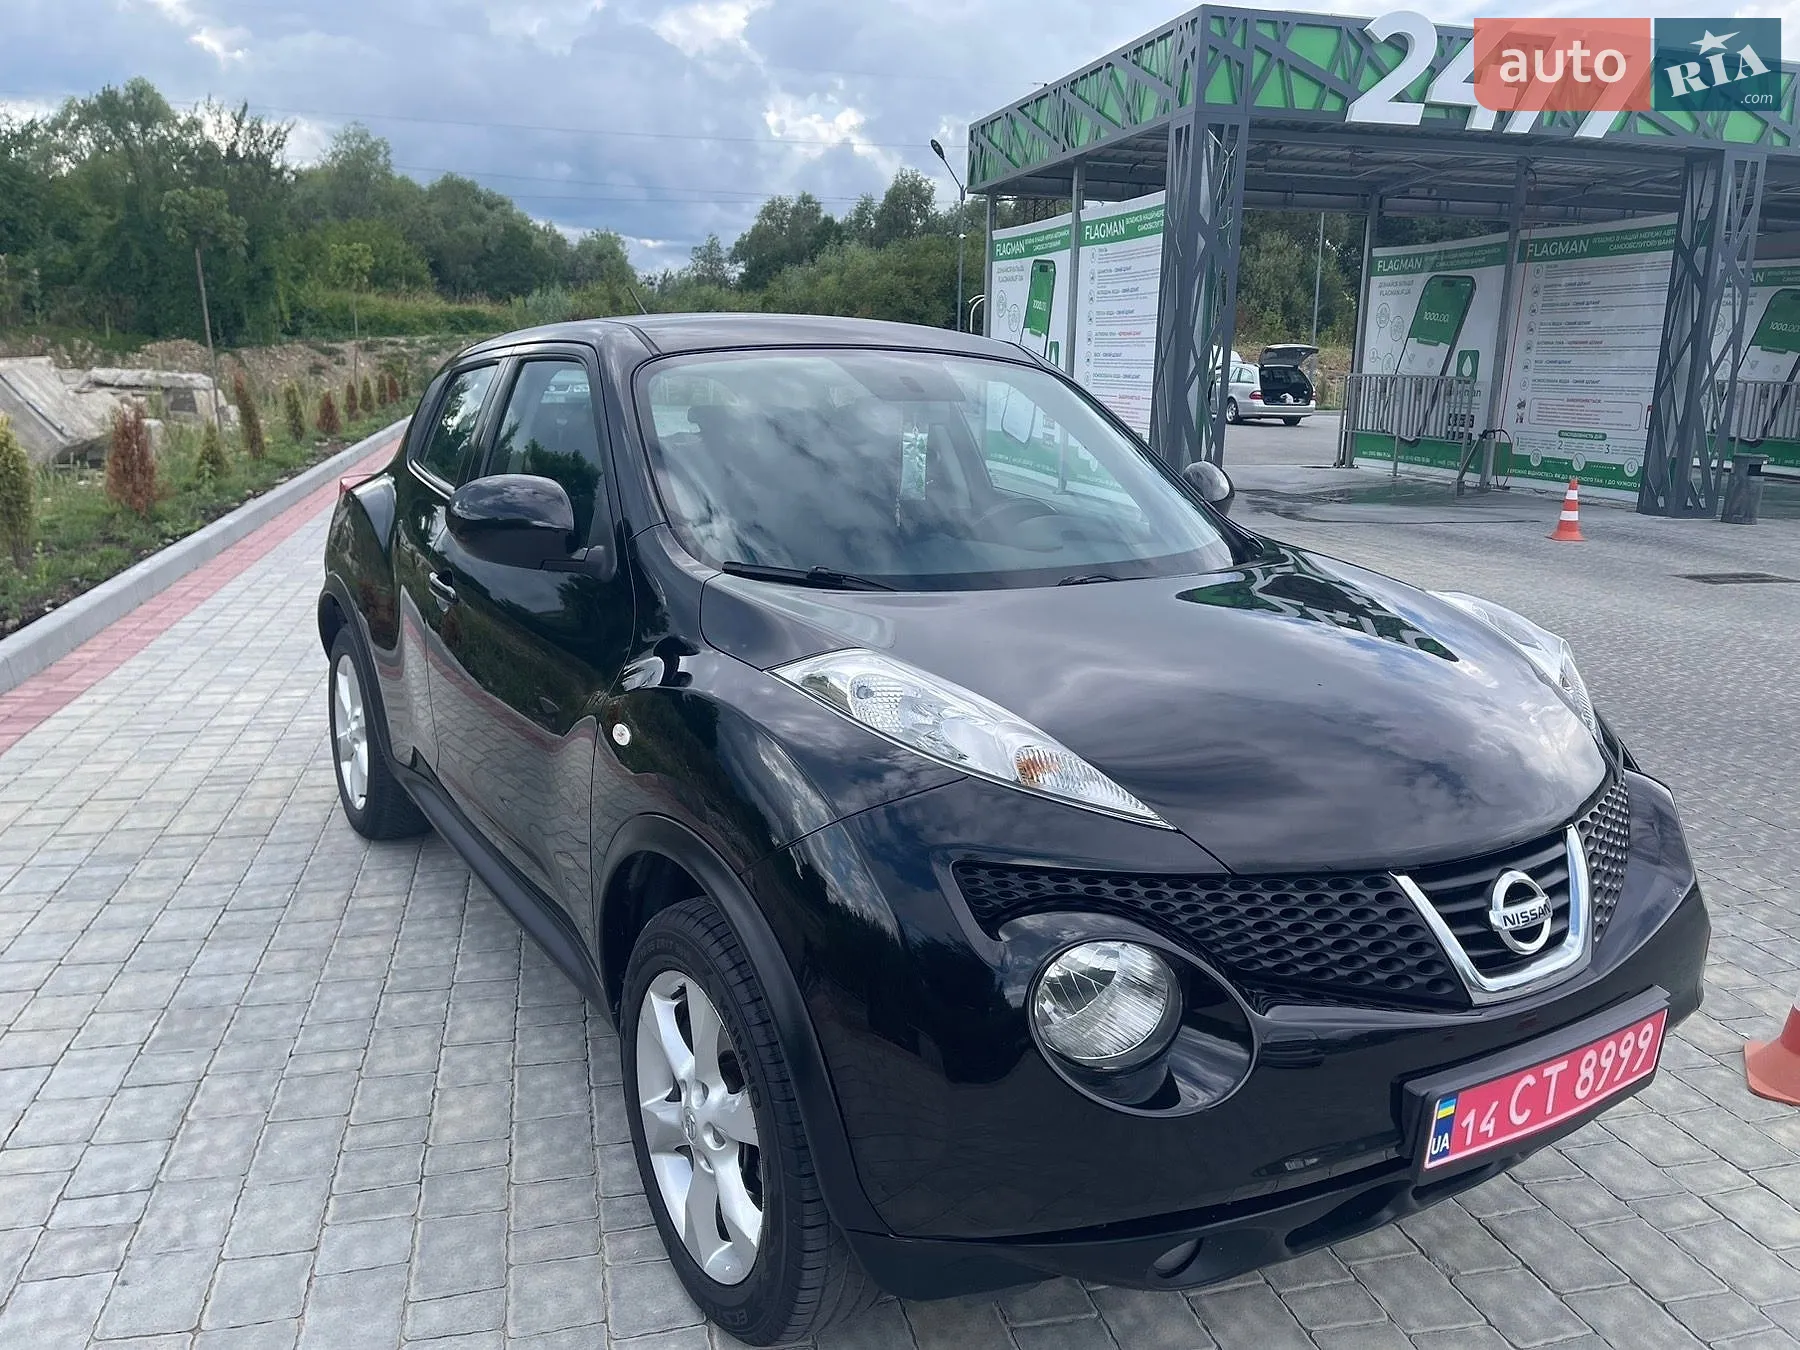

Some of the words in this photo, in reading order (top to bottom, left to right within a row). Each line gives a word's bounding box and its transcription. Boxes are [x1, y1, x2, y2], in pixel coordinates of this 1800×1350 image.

[1085, 219, 1126, 241] FLAGMAN
[995, 240, 1025, 257] FLAGMAN
[1526, 239, 1590, 257] FLAGMAN
[1377, 257, 1423, 272] FLAGMAN
[1502, 903, 1551, 927] NISSAN
[1460, 1101, 1499, 1146] 14
[1509, 1060, 1569, 1125] CT
[1574, 1022, 1654, 1100] 8999
[1431, 1132, 1450, 1155] UA
